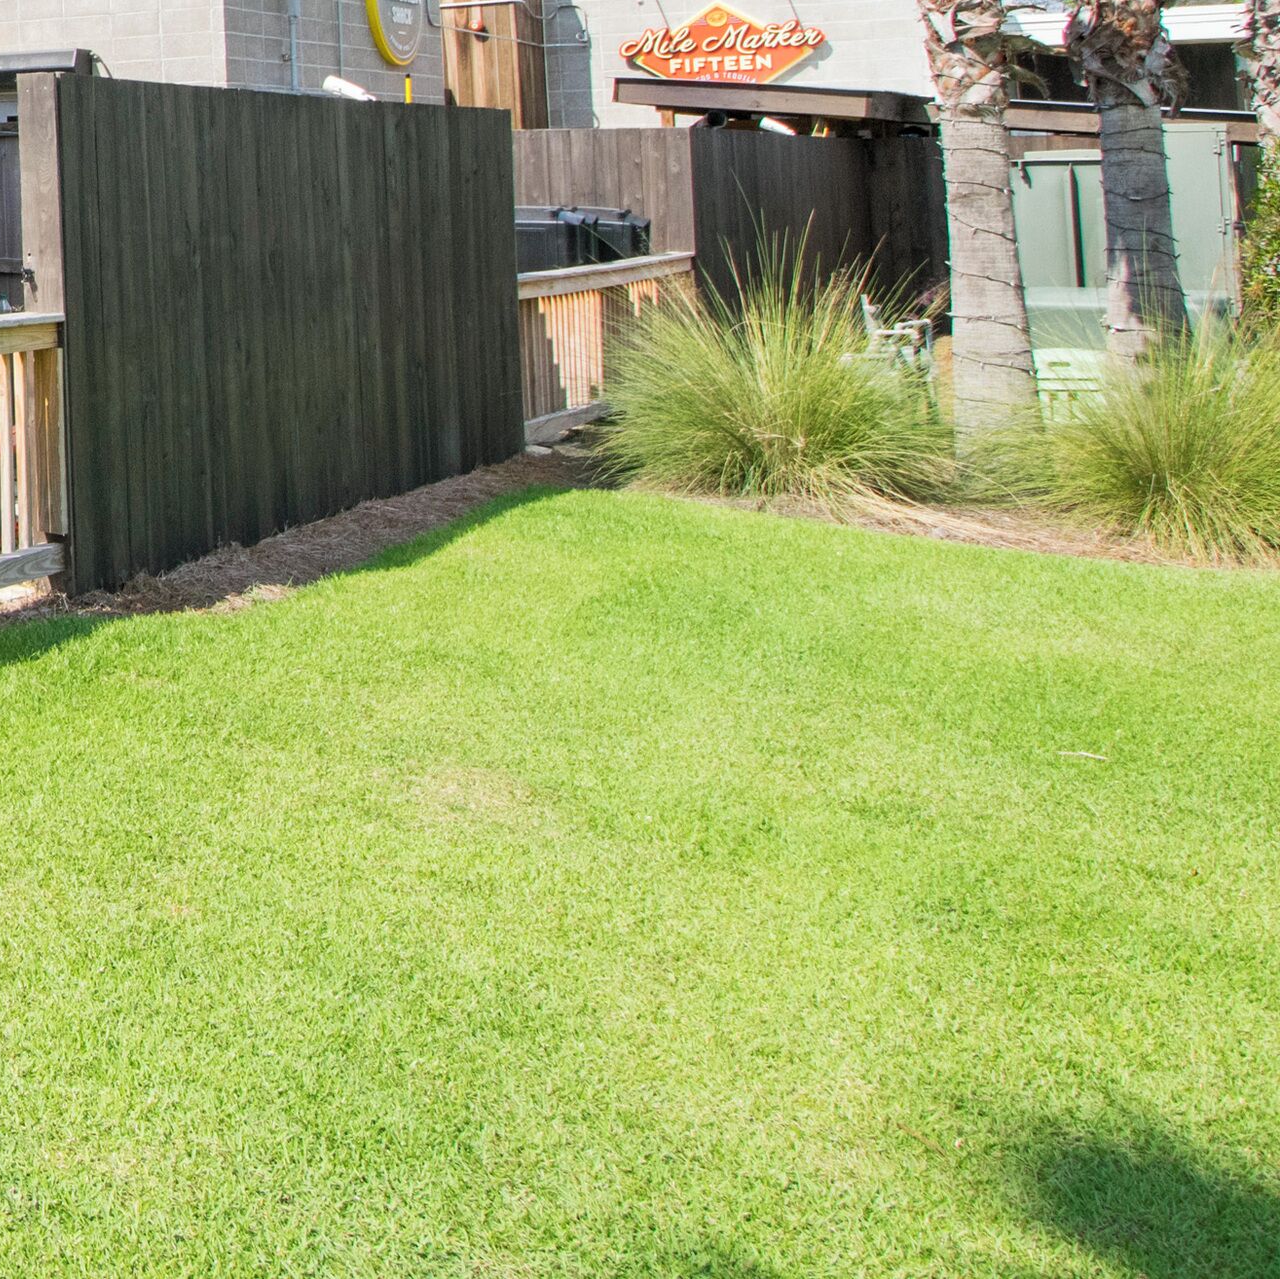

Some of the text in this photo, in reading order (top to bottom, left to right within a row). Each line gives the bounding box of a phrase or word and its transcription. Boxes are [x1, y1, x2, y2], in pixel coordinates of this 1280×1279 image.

[621, 21, 823, 59] Mile Marker
[669, 54, 772, 74] FIFTEEN
[722, 71, 757, 84] TEQUILA
